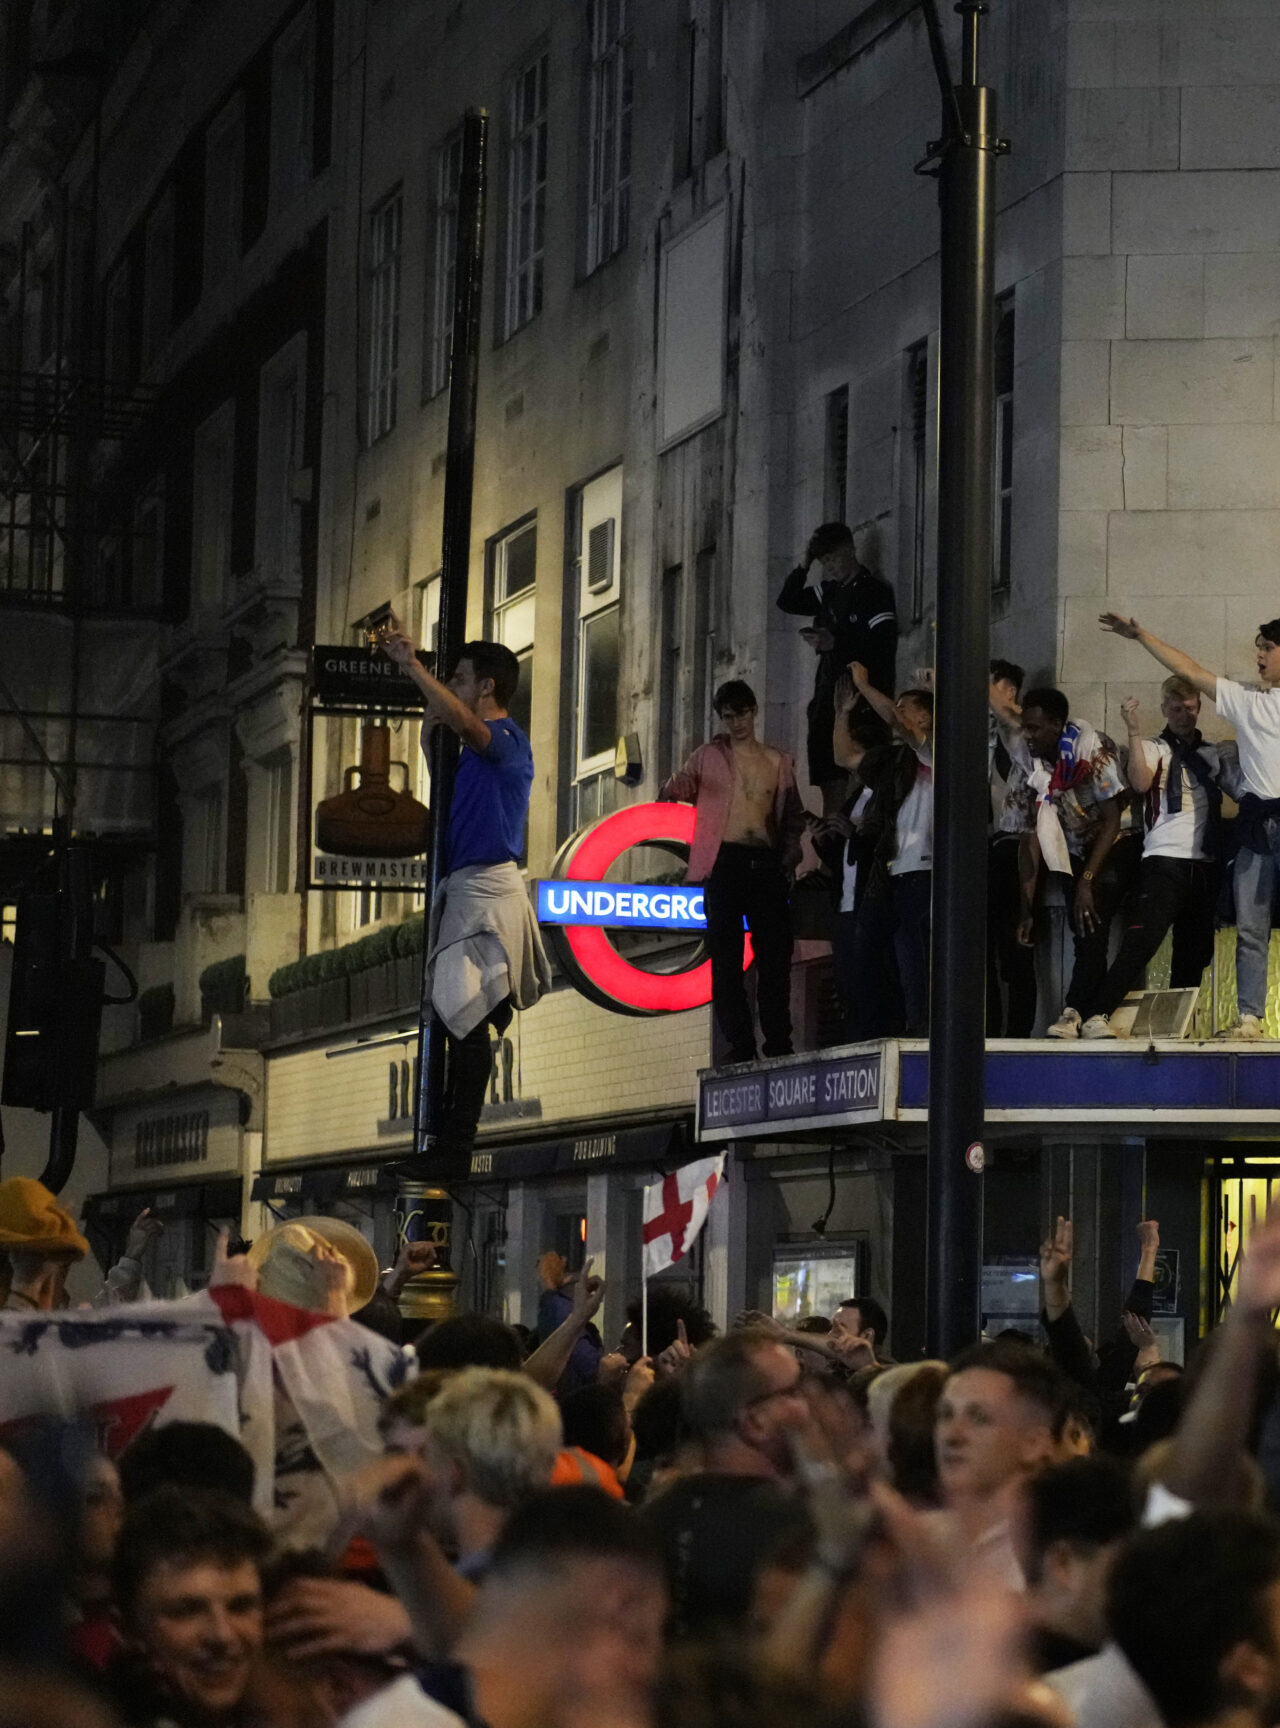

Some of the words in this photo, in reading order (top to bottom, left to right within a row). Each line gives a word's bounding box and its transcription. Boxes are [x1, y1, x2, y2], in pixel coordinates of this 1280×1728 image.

[324, 658, 392, 676] GREENE
[318, 861, 427, 878] BREWMASTER
[547, 889, 707, 921] UNDERGRO
[706, 1084, 762, 1117] LEICESTER
[768, 1075, 817, 1109] SQUARE
[824, 1067, 878, 1102] STATION
